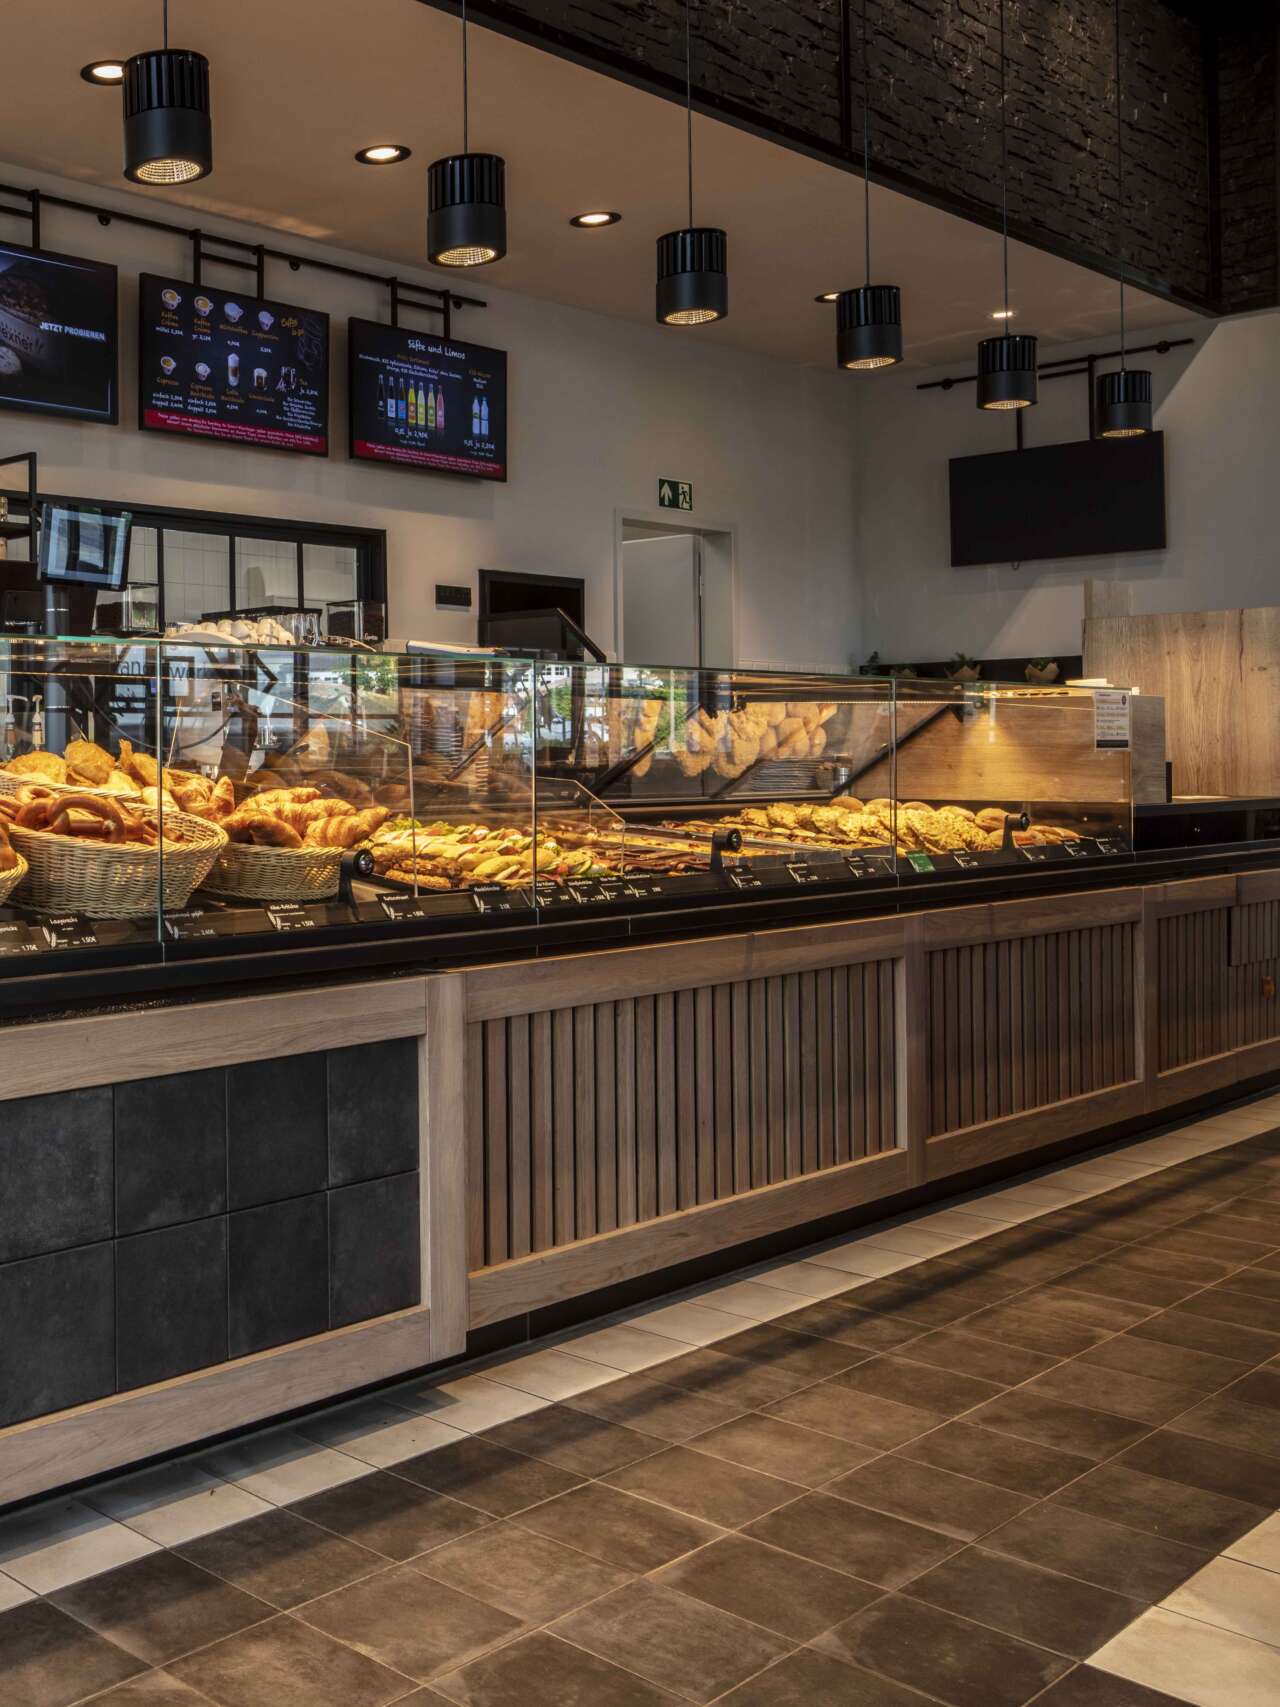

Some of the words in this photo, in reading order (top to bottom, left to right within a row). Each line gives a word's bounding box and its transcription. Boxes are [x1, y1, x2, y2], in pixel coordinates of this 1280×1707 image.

[39, 321, 62, 333] JETZT
[64, 325, 106, 342] PROBIEREN
[428, 344, 442, 354] und
